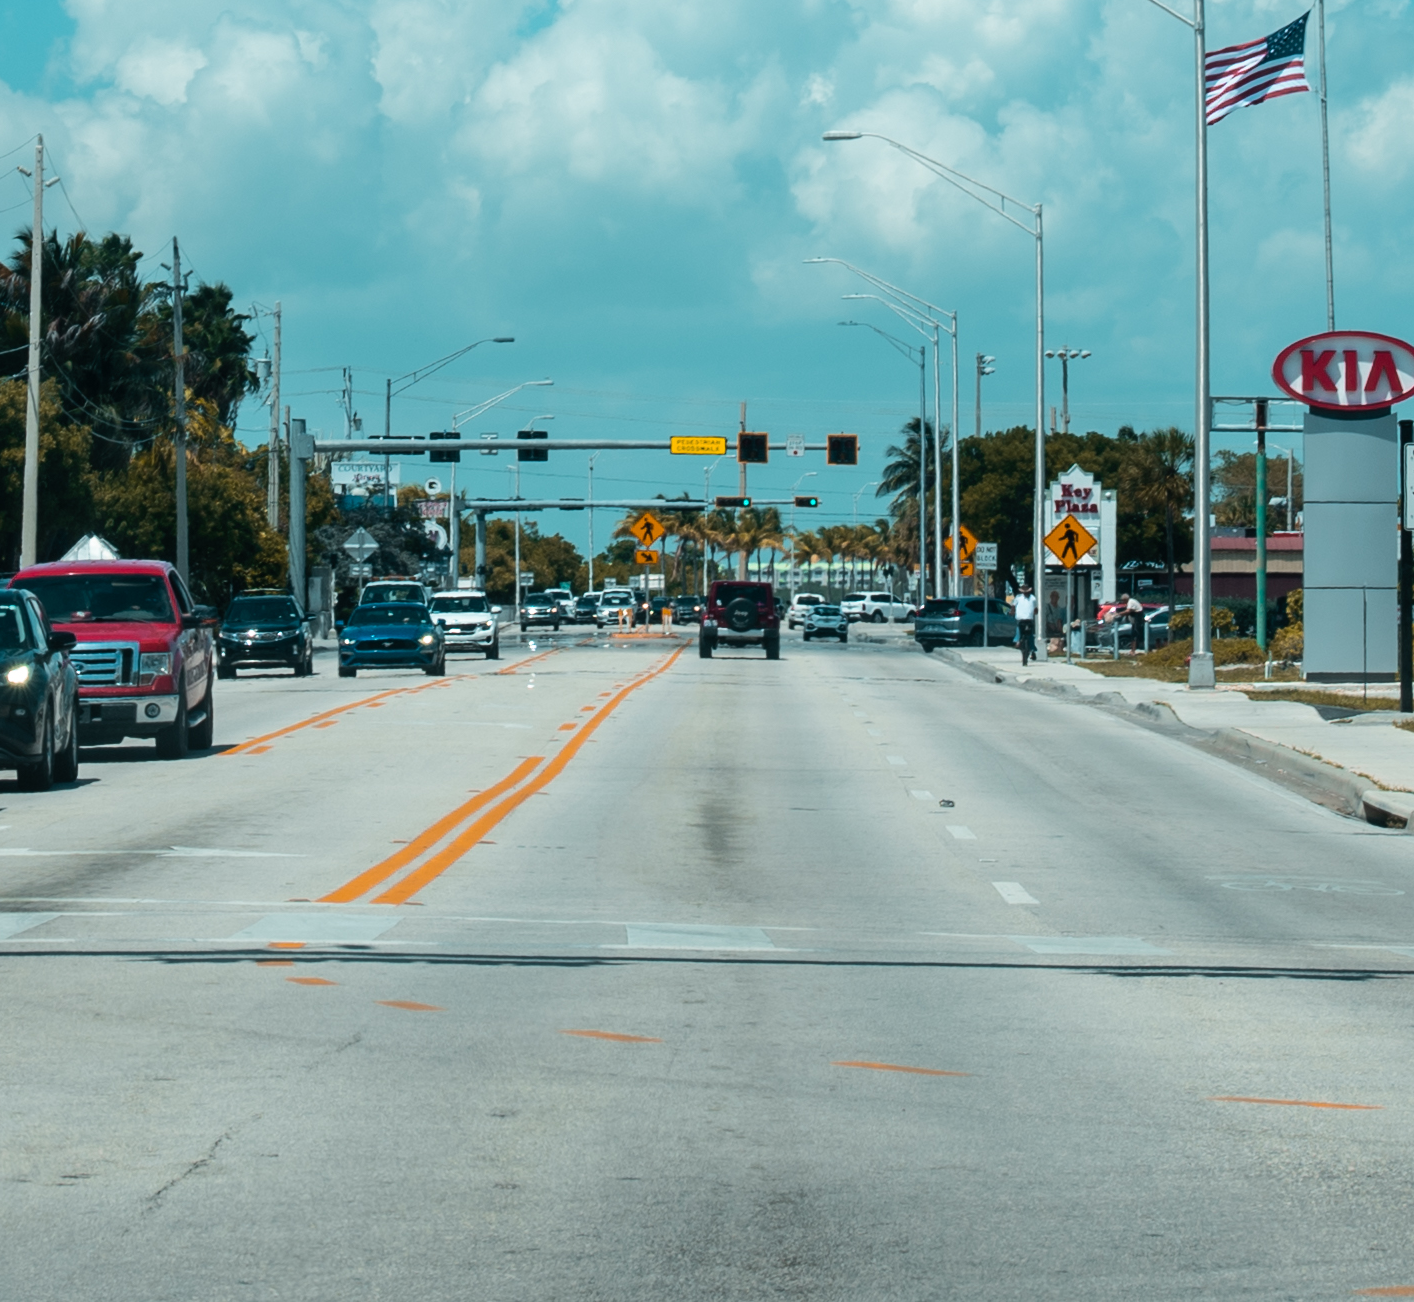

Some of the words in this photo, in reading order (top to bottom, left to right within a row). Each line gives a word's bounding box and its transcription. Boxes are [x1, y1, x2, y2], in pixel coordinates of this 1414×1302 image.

[1300, 350, 1404, 393] KIA
[1061, 484, 1092, 499] Key
[1054, 500, 1098, 513] Plaza
